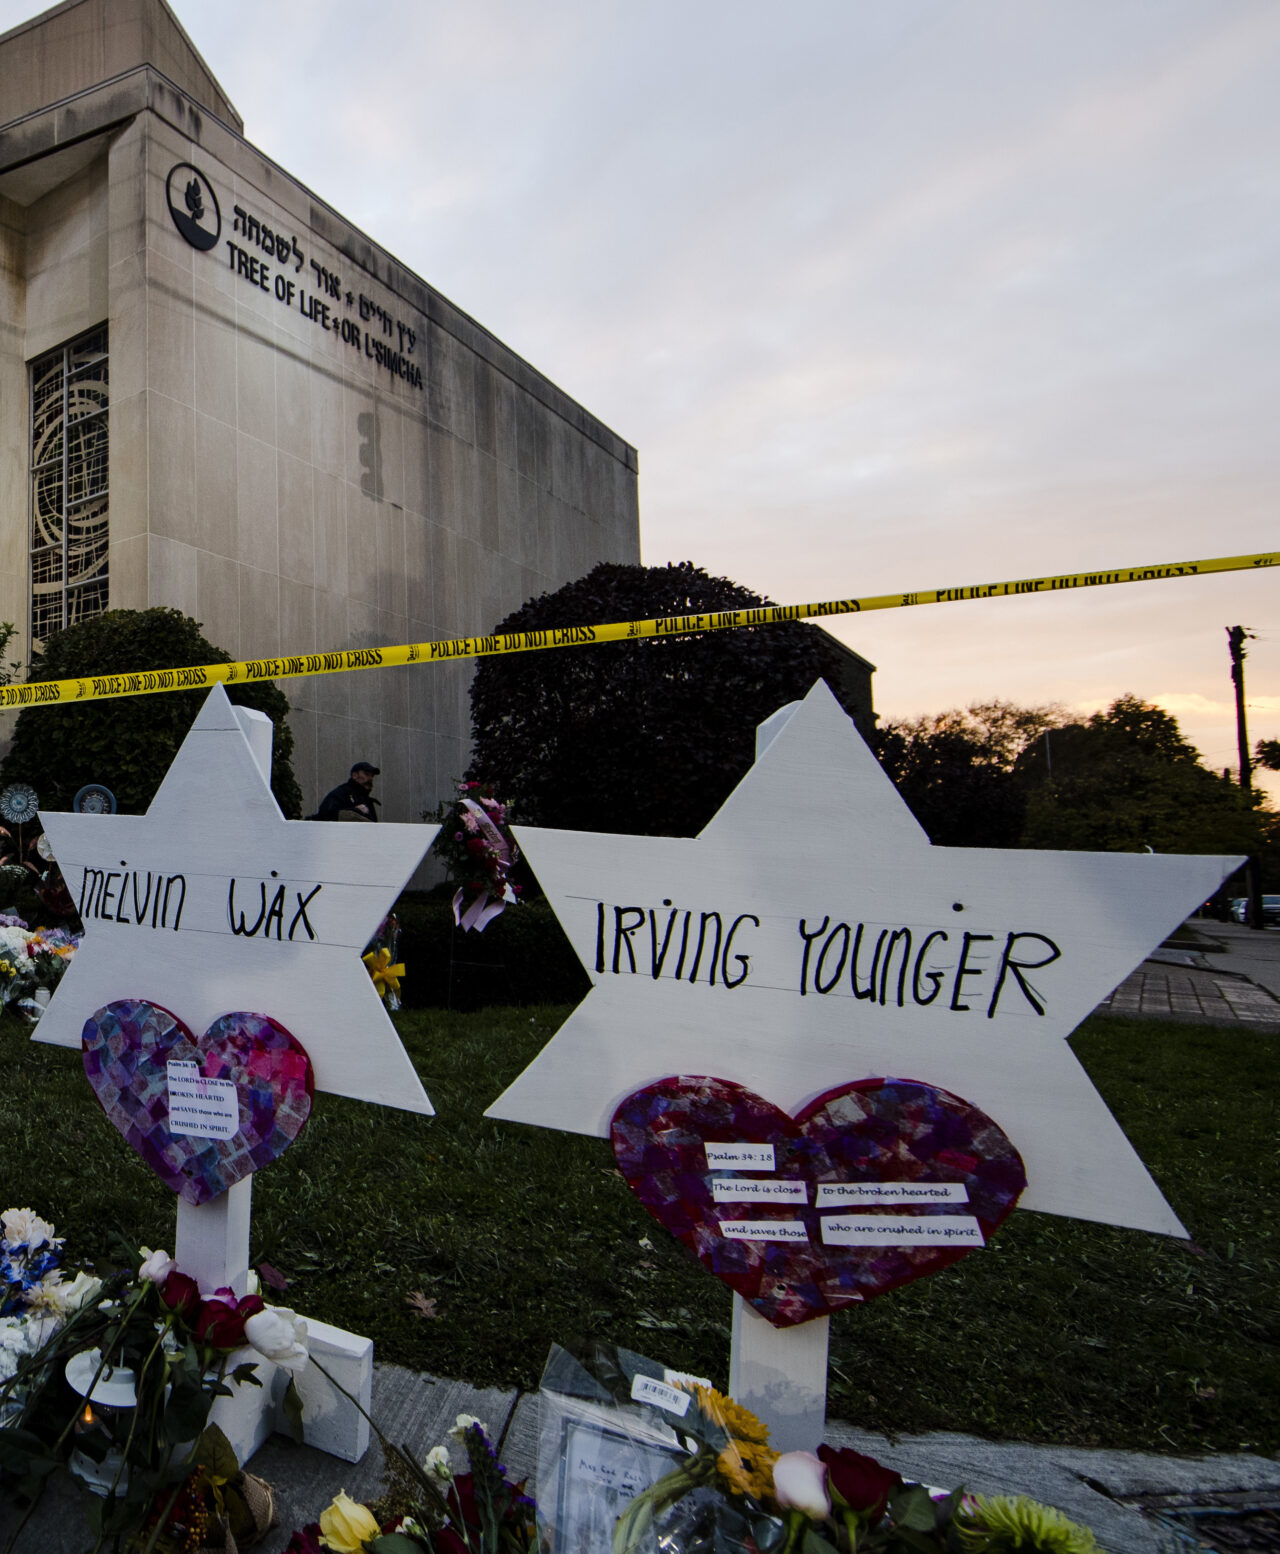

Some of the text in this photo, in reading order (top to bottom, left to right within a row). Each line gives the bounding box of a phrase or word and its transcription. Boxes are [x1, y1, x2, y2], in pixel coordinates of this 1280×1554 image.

[233, 204, 304, 273] לשמחה
[310, 258, 341, 301] אור
[226, 240, 424, 390] TREE OF LIFE OR L'SIMCHA
[655, 615, 704, 633] POLICE
[709, 612, 741, 628] LINE
[745, 609, 766, 624] DO
[772, 606, 800, 621] NOT
[430, 625, 596, 658] POLICE LINE DO NOT CROSS
[246, 648, 383, 679] POLICE LINE DO NOT CROSS
[92, 668, 207, 696] POLICE LINE DO NOT CROSS
[5, 688, 18, 705] DO
[18, 686, 33, 704] NOT
[34, 683, 60, 702] CROSS
[79, 867, 322, 941] MELVIN WAX
[597, 902, 1061, 1018] IRVING YOUNGER
[200, 1078, 218, 1086] CLOSE
[196, 1093, 224, 1101] HEARTED
[180, 1106, 198, 1114] SAVES
[171, 1120, 198, 1128] CRUSHED
[707, 1152, 773, 1161] Psalm 34: 18
[713, 1183, 802, 1194] The Lord is close
[822, 1186, 951, 1197] to the broken hearted
[724, 1226, 807, 1237] and saves those
[828, 1223, 851, 1232] who
[854, 1225, 876, 1233] are
[877, 1225, 924, 1235] crushed
[927, 1226, 941, 1235] in
